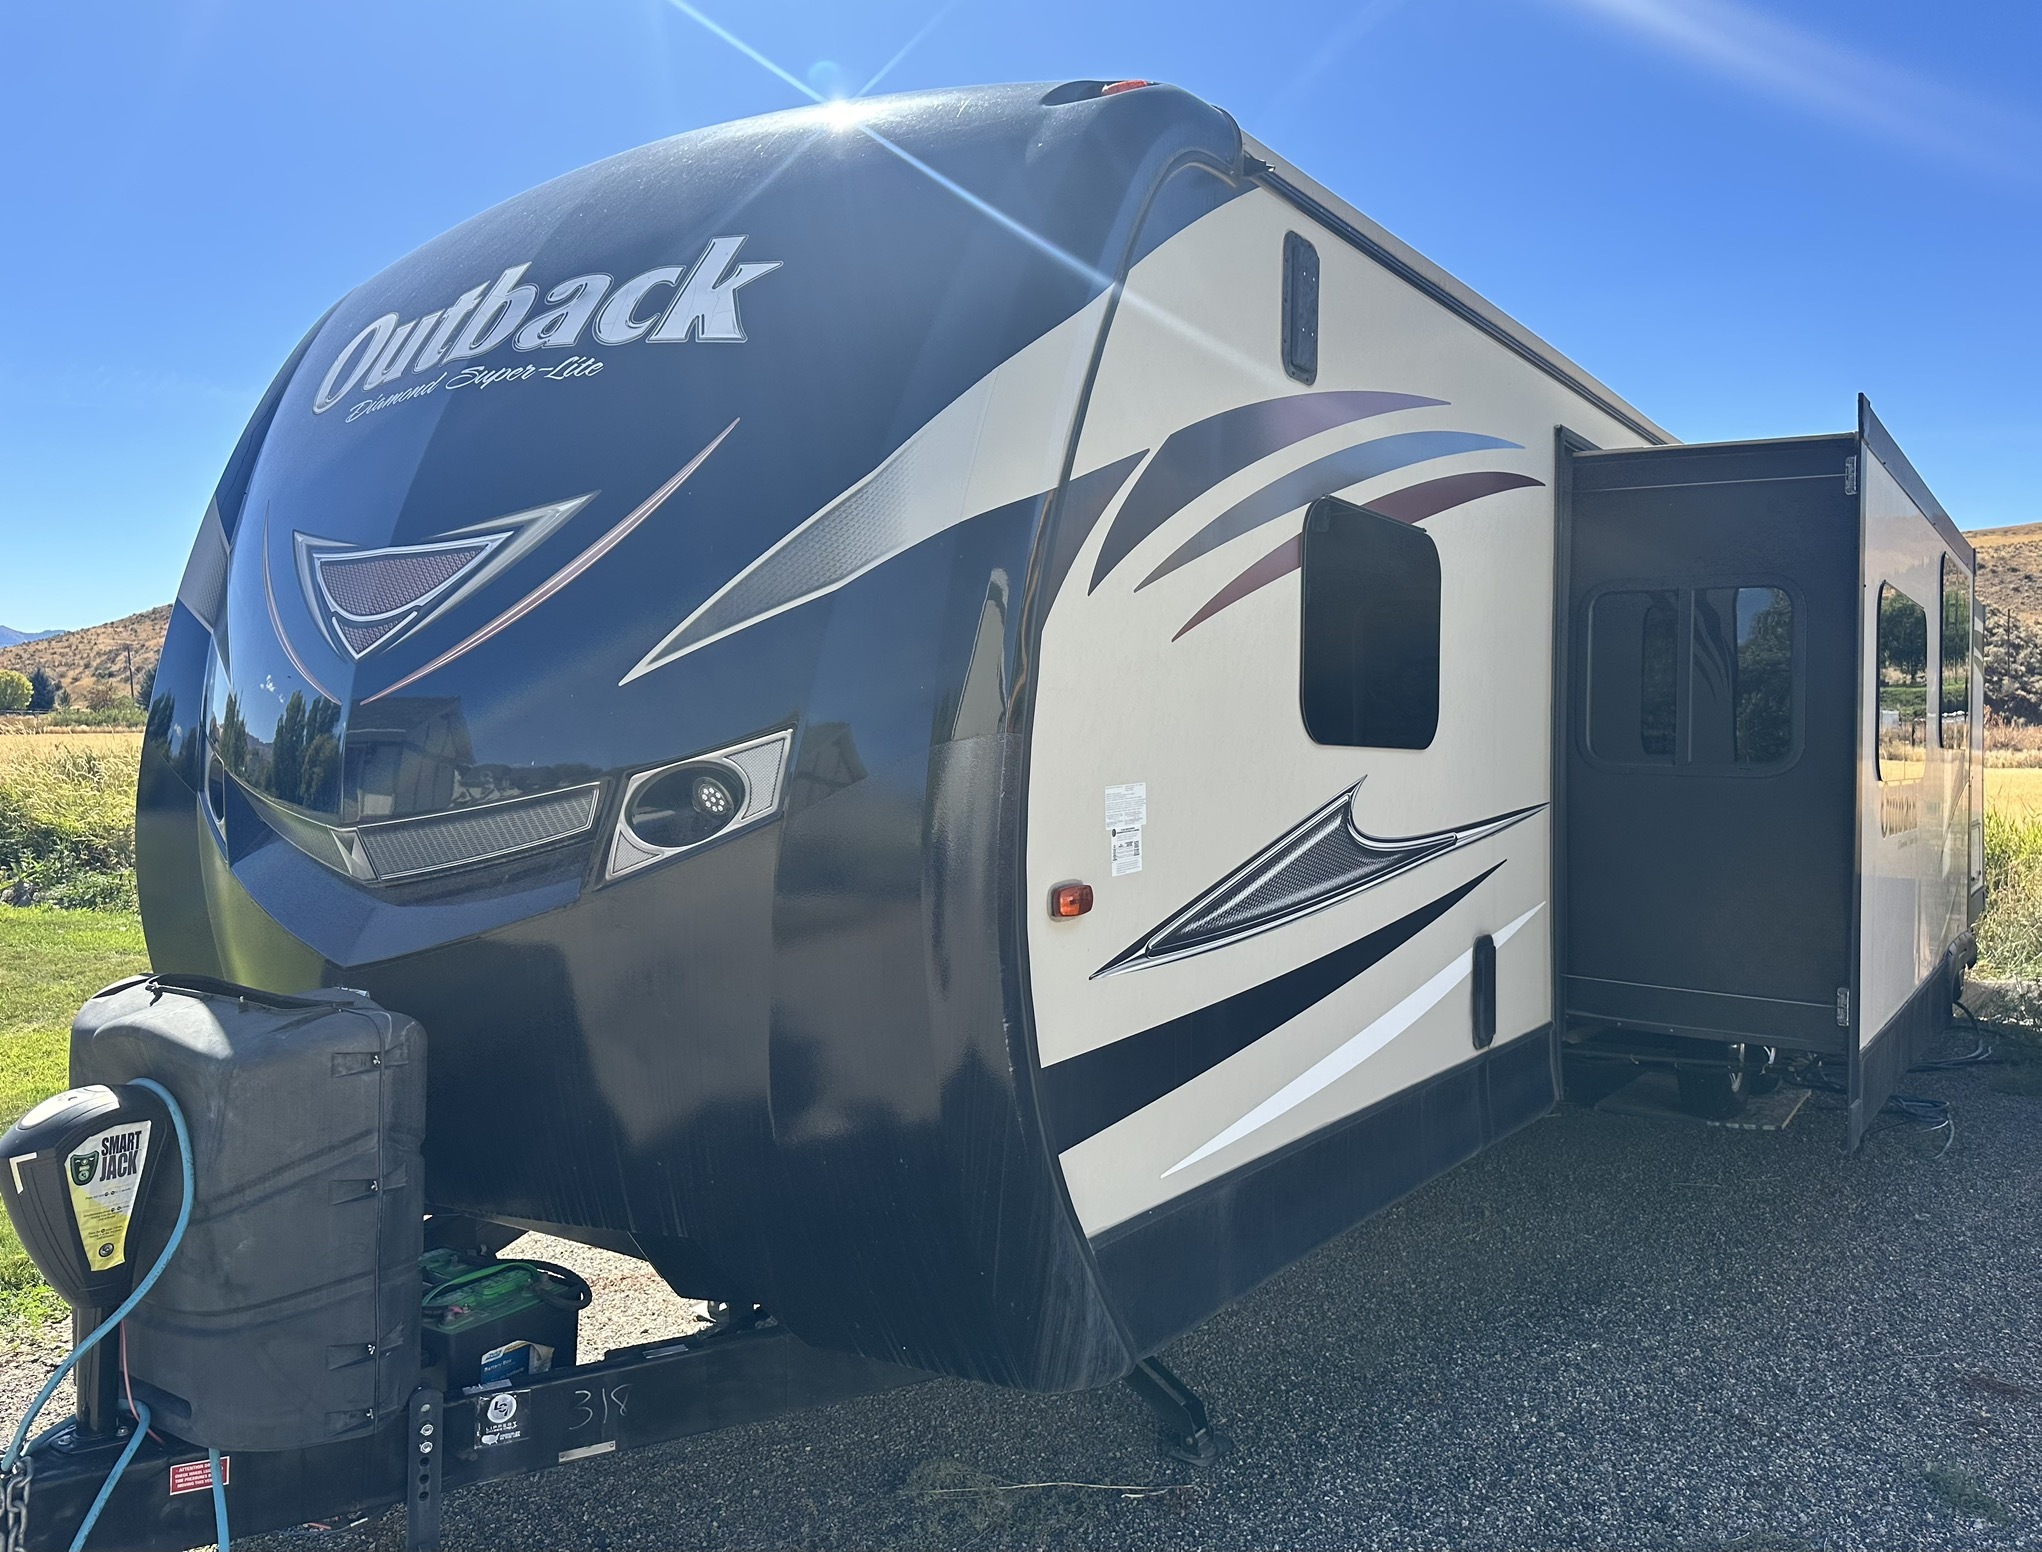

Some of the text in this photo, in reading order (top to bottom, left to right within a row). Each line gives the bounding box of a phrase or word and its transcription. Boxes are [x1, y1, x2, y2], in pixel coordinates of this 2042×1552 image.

[312, 235, 784, 416] Outback
[345, 355, 606, 423] Diamond Super-Lite
[101, 1130, 142, 1156] SMART
[99, 1150, 138, 1182] JACK
[484, 1362, 502, 1373] Battery
[568, 1384, 634, 1430] 318
